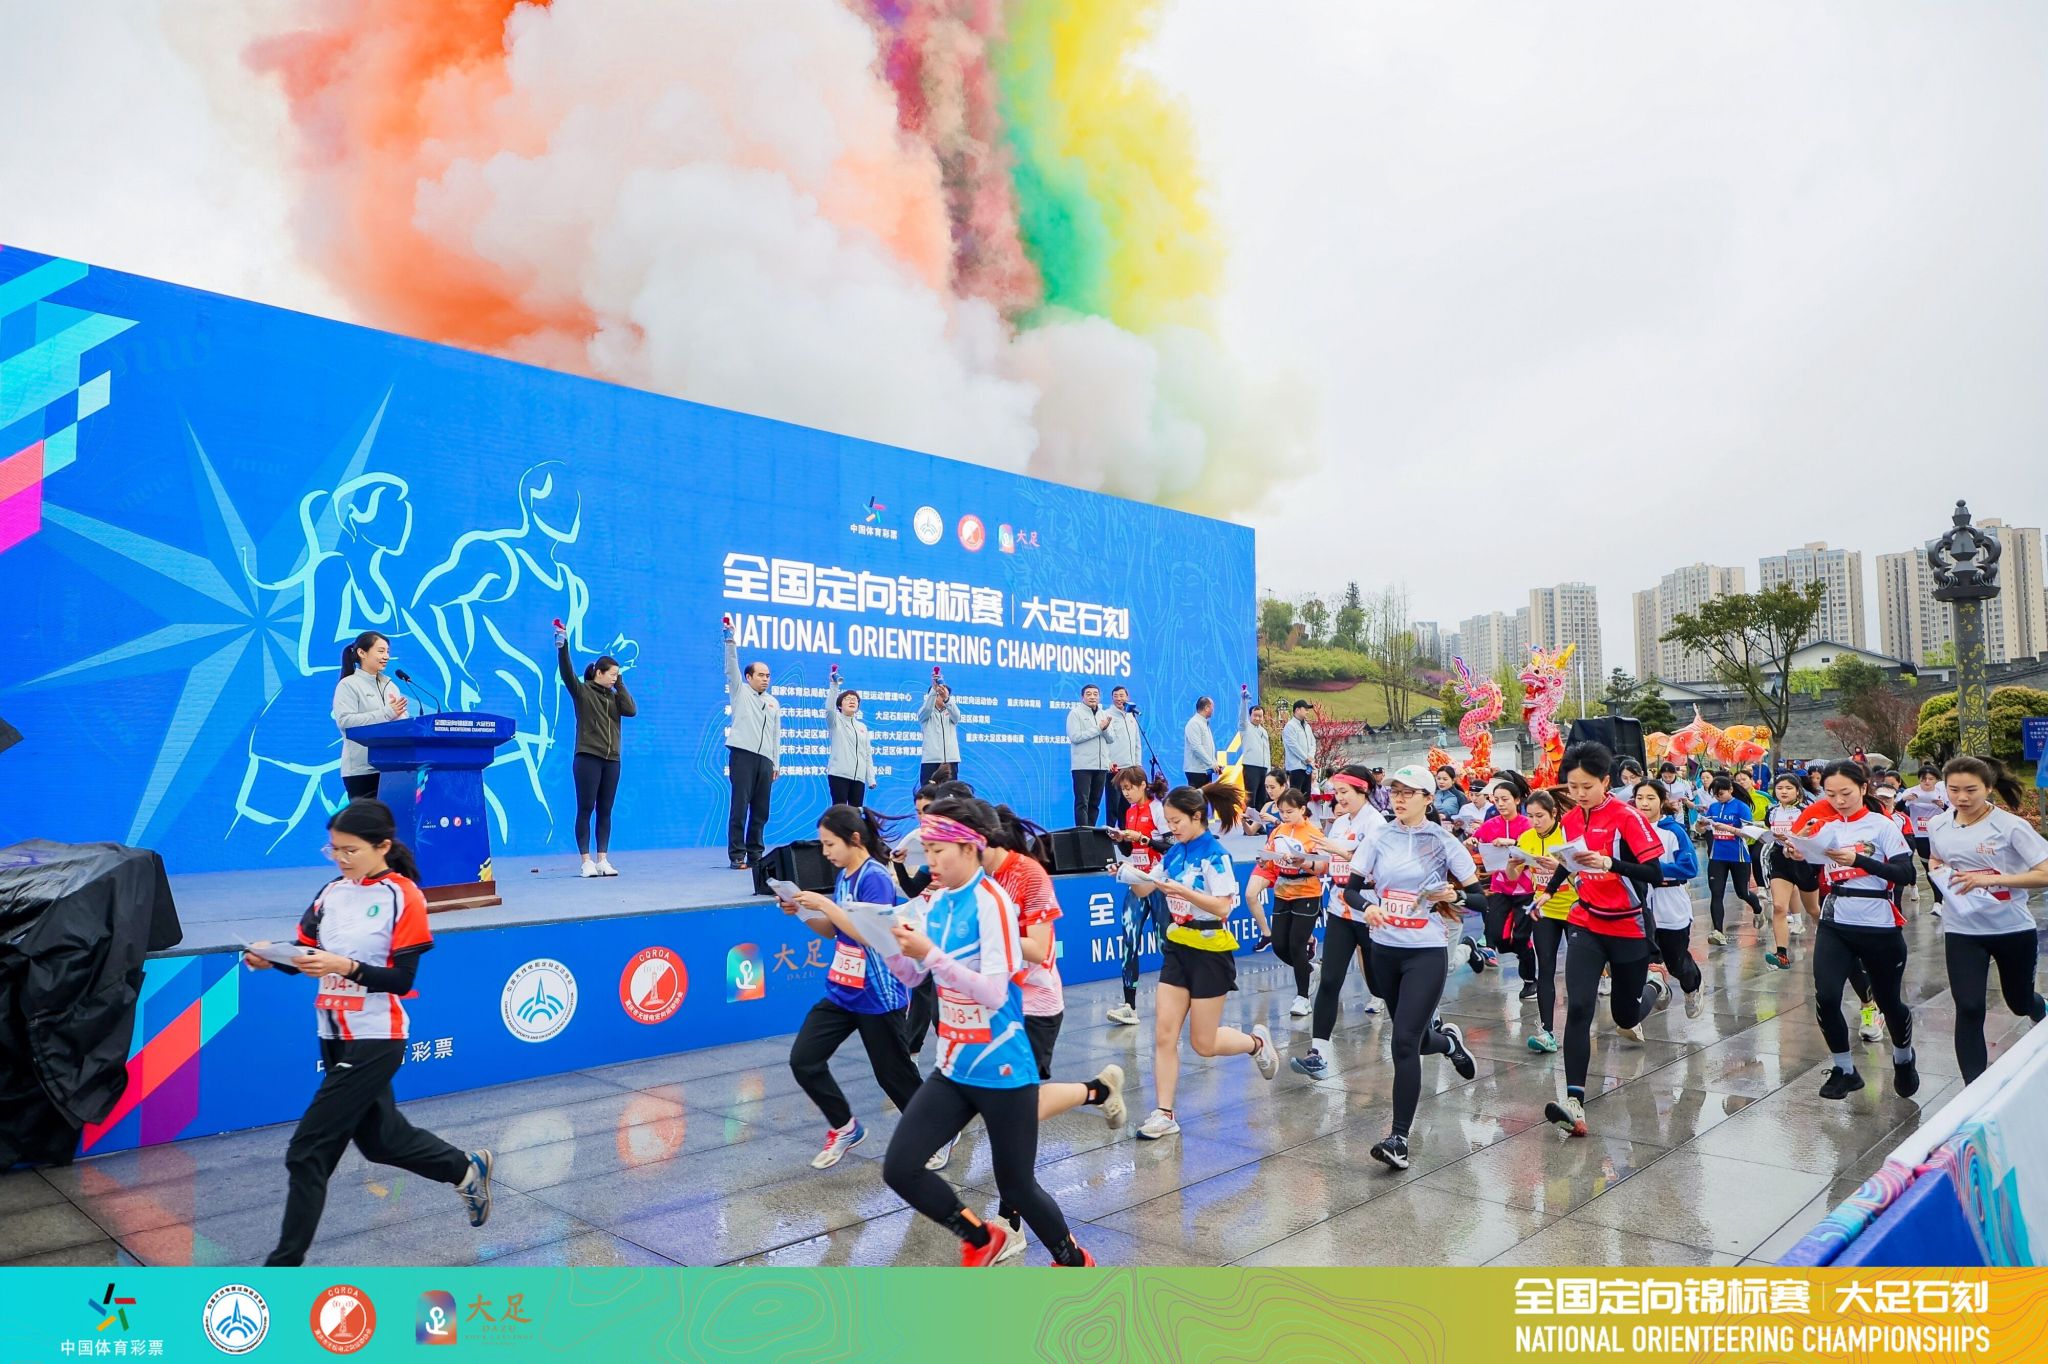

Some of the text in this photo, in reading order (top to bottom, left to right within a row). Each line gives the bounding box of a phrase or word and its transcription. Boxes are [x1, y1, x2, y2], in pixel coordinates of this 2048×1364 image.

[850, 523, 898, 540] 中国体育彩票
[1017, 530, 1040, 547] 大足
[723, 552, 1130, 640] 全国定向锦标赛 大足石刻
[725, 612, 1131, 677] NATIONAL ORIENTEERING CHAMPIONSHIPS
[772, 938, 829, 973] 大足
